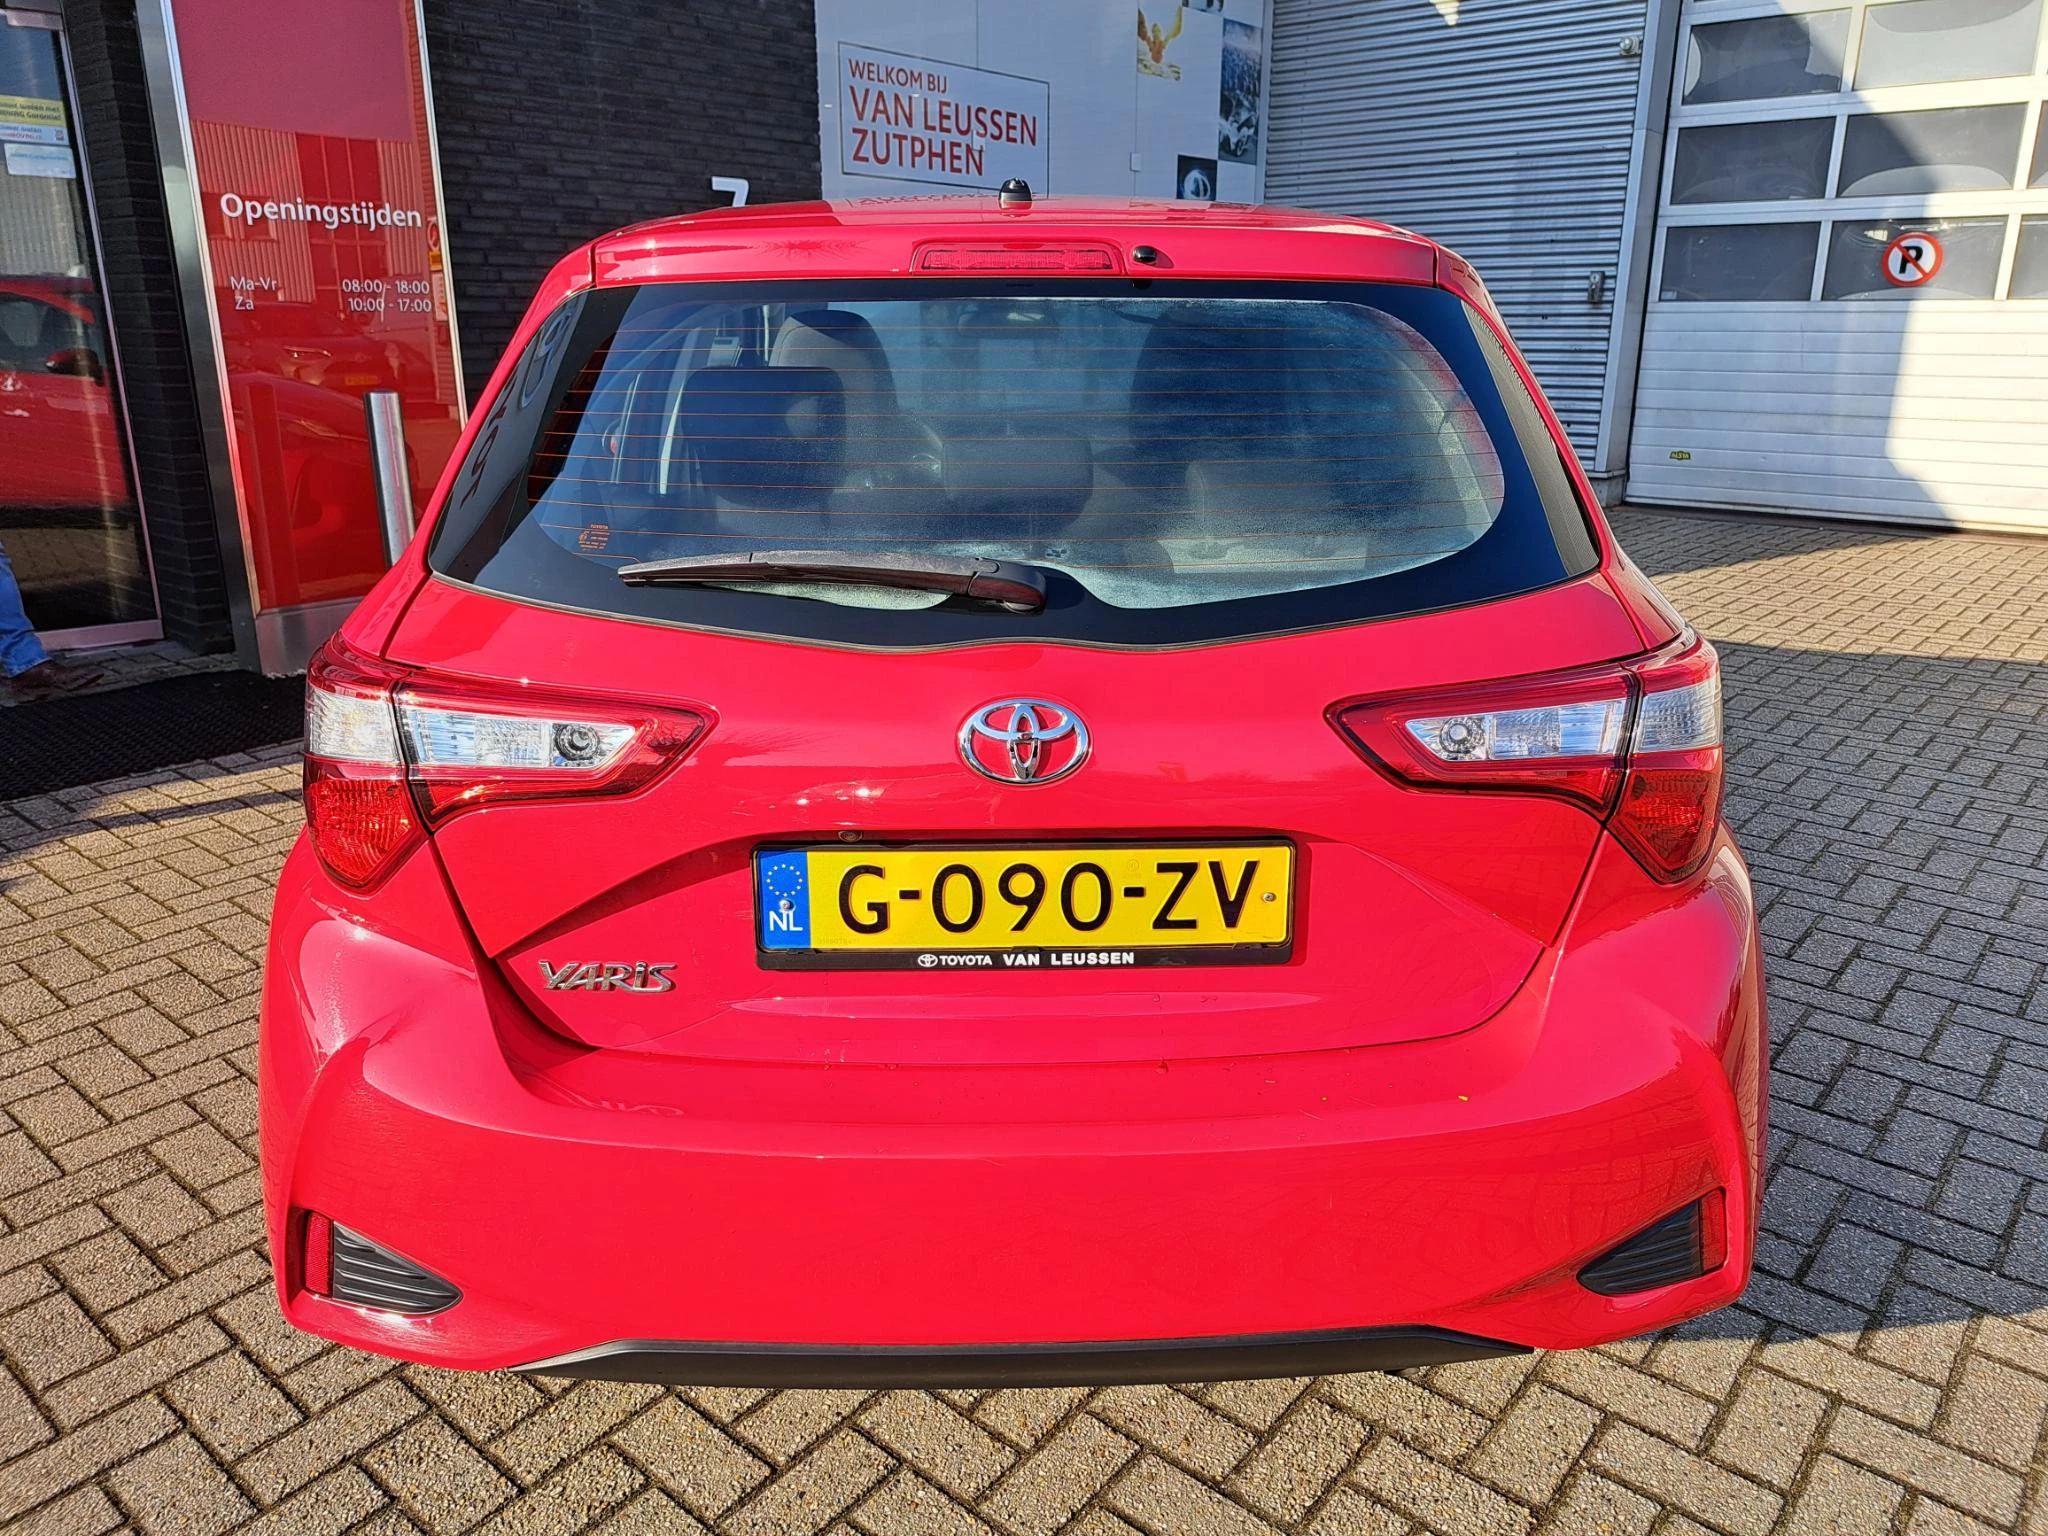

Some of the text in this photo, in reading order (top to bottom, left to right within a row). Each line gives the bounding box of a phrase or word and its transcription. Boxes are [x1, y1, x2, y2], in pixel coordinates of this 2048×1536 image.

[848, 58, 948, 94] WELKOM BIJ
[849, 85, 1037, 146] VAN LEUSSEN
[851, 127, 984, 176] ZUTPHEN
[220, 192, 422, 232] Openingstijden
[230, 275, 278, 291] Ma-Vr
[342, 279, 383, 294] 08:00
[395, 280, 430, 295] 18:00
[235, 295, 255, 311] Za
[348, 297, 384, 312] 10:00
[399, 298, 432, 313] 17:00
[838, 860, 1260, 935] G-090-ZV
[769, 910, 804, 932] NL
[939, 951, 1135, 966] TOYOTA VAN LEUSSEN
